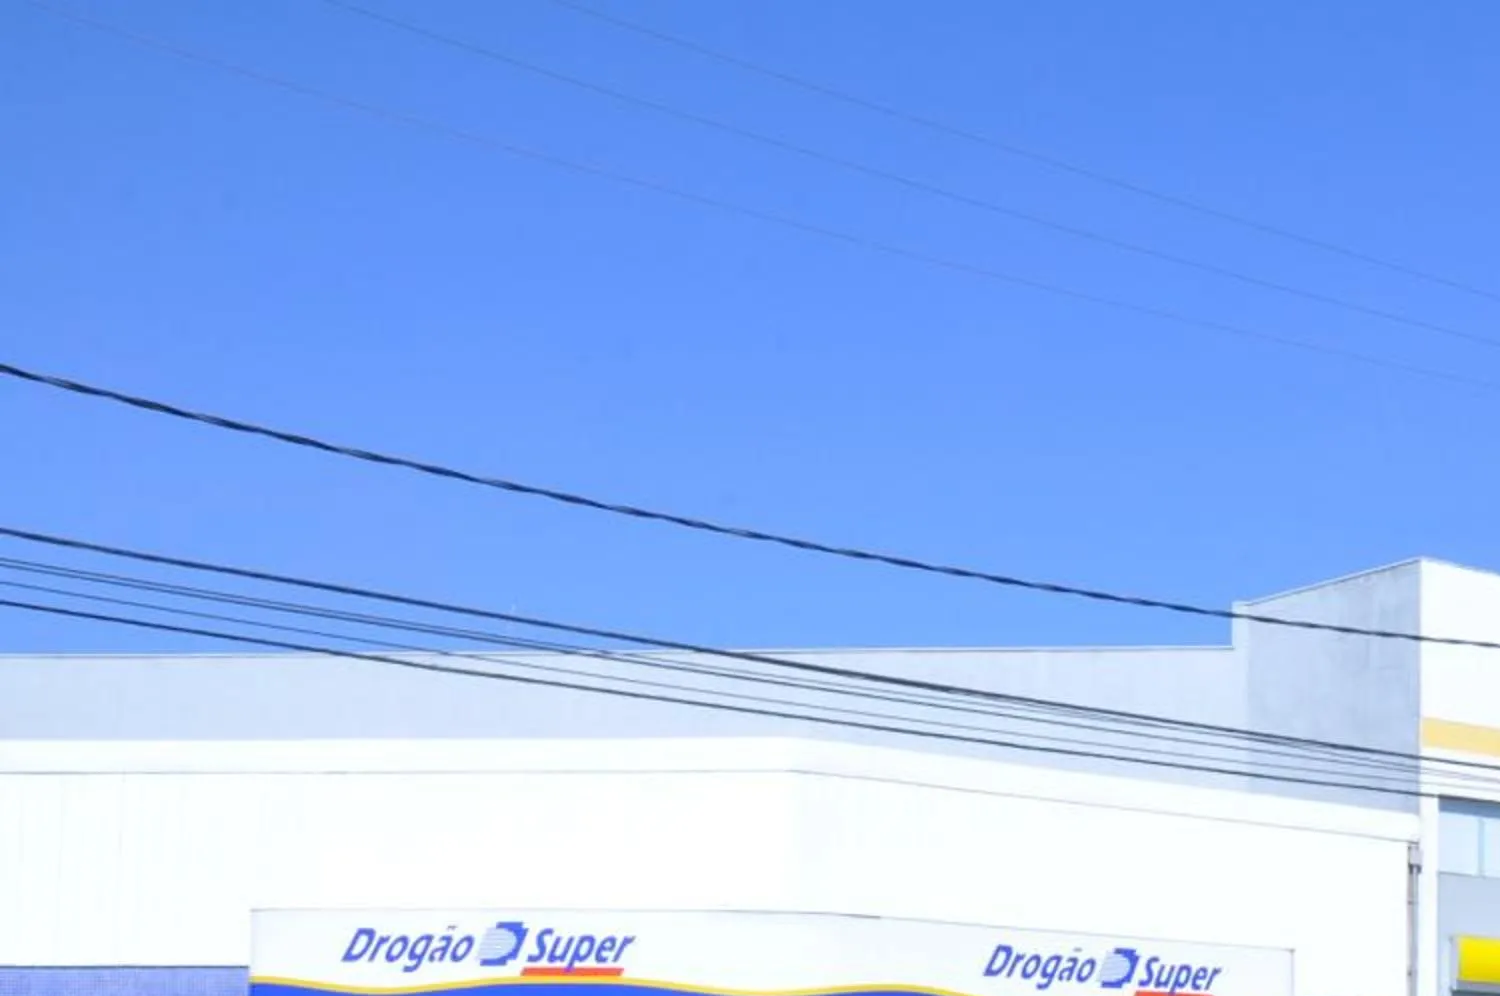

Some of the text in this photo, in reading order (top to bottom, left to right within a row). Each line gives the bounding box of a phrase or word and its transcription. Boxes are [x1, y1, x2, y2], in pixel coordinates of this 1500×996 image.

[341, 924, 636, 974] Drogão Super
[983, 944, 1222, 996] Drogão Super
